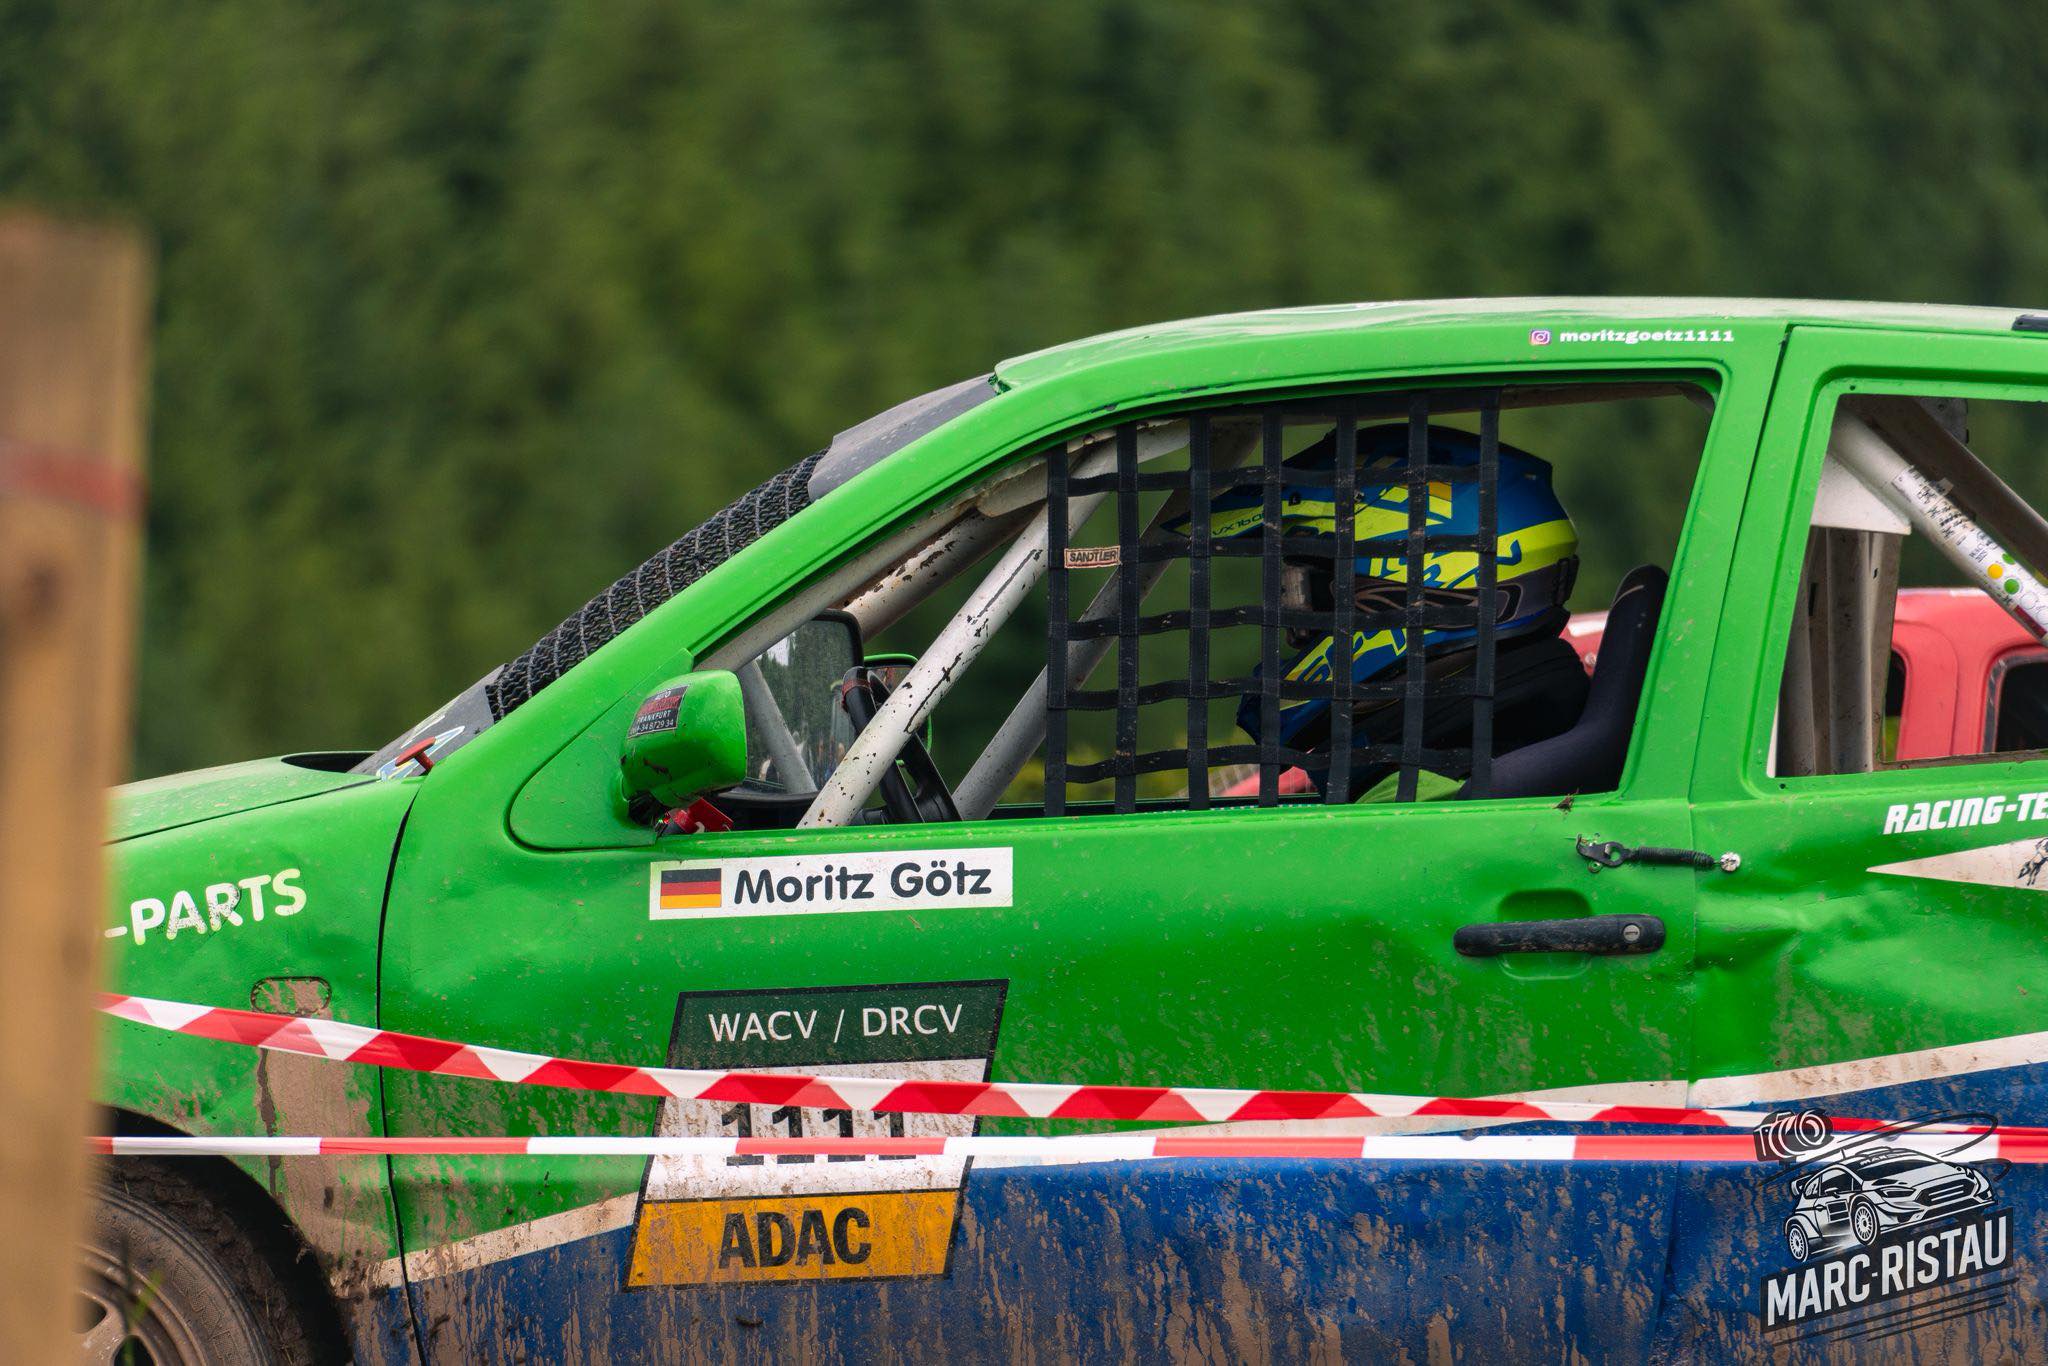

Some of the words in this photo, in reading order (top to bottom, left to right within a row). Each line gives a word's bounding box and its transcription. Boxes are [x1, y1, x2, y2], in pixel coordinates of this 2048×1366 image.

[1560, 329, 1734, 344] moritzgoetz1111
[1069, 550, 1117, 562] SANDTLER
[734, 866, 874, 904] Moritz
[891, 860, 992, 898] Götz
[708, 1010, 818, 1043] WACV
[863, 1004, 963, 1036] DRCV
[718, 1207, 872, 1269] ADAC
